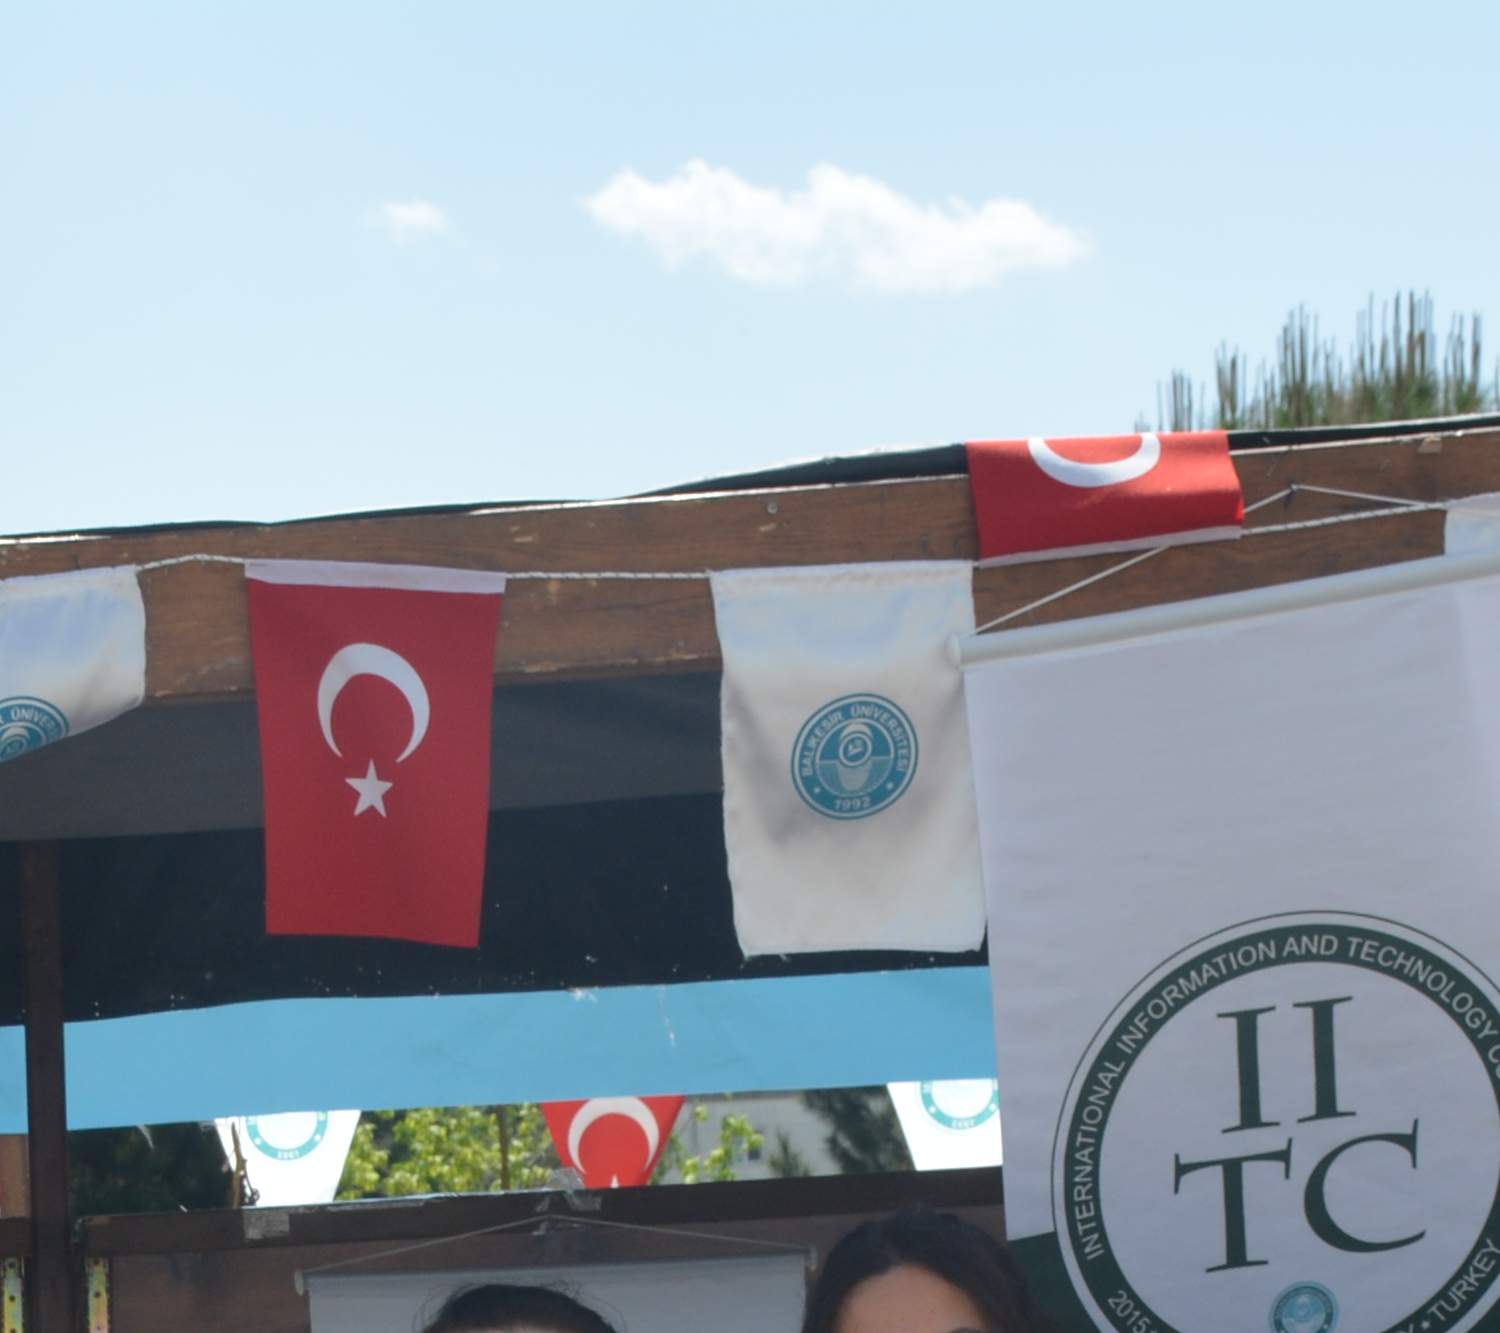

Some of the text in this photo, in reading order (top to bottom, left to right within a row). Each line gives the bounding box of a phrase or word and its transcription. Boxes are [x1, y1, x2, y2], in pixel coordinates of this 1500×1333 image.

[802, 710, 845, 777] BALIKESİR
[834, 796, 872, 811] 1992
[1074, 1060, 1125, 1260] INTERNATIONAL
[1116, 936, 1278, 1056] INFORMATION
[1282, 933, 1340, 958] AND
[1346, 935, 1499, 1044] TECHNOLOGY
[1216, 996, 1357, 1134] II
[1173, 1118, 1427, 1273] TC
